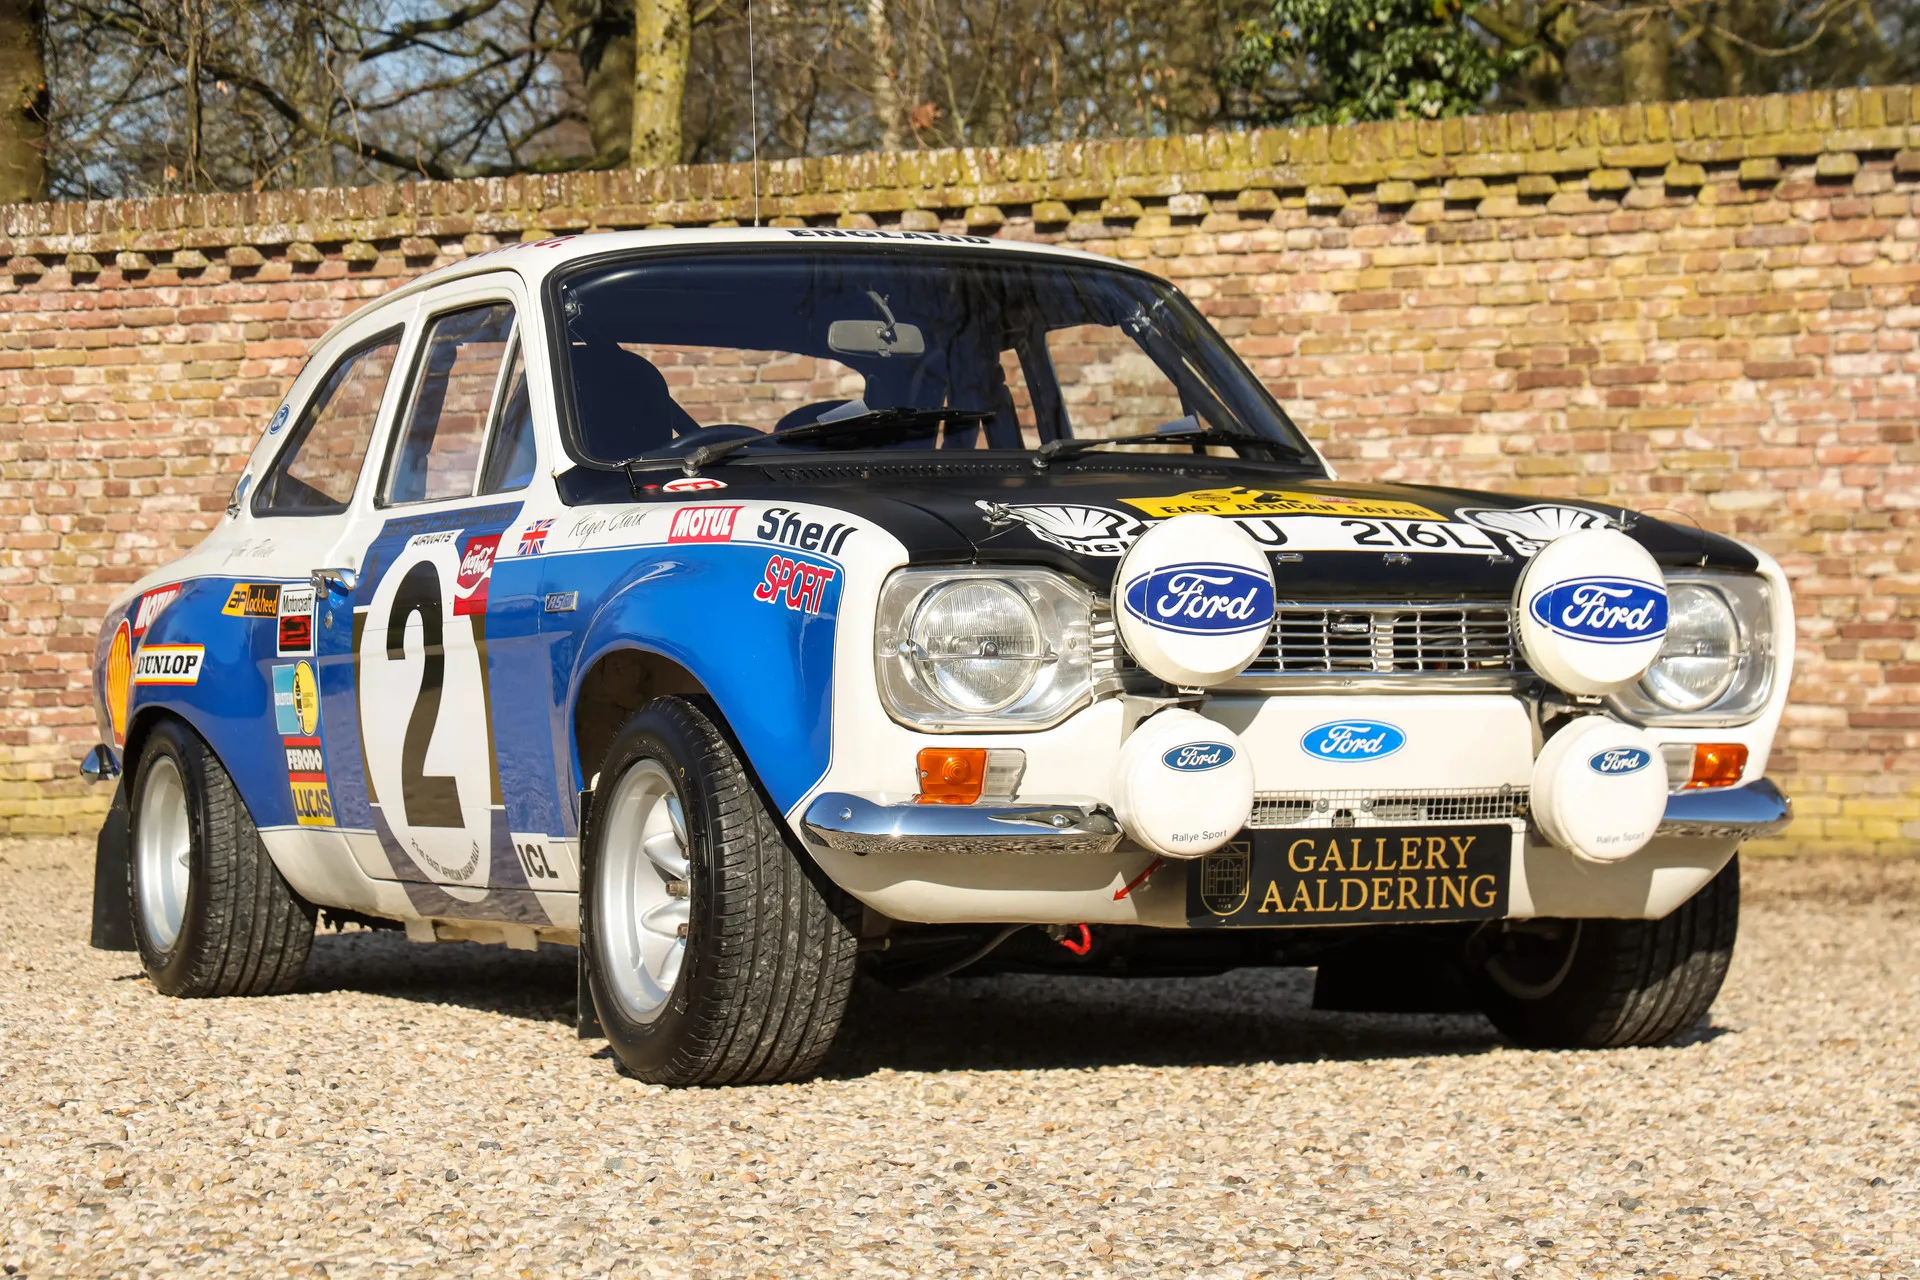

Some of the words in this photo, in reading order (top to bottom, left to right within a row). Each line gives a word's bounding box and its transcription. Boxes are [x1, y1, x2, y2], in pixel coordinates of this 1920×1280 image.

[786, 229, 991, 244] ENGLAND
[671, 507, 735, 538] MOTUL
[1160, 505, 1222, 514] EAST
[1236, 503, 1337, 512] AFRICAN
[1347, 506, 1431, 517] SAFARI
[412, 532, 455, 546] AIRWAYS
[757, 508, 858, 556] Shell
[1341, 520, 1495, 549] 216L
[755, 556, 836, 615] SPORT
[1157, 572, 1257, 620] Ford
[245, 588, 279, 615] Lockheed
[282, 594, 312, 613] Motorcraft
[1562, 584, 1655, 631] Ford
[137, 655, 198, 675] DUNLOP
[387, 560, 465, 829] 2
[1319, 725, 1386, 754] Ford
[286, 748, 323, 771] FERODO
[1177, 746, 1221, 767] Ford
[1600, 750, 1640, 772] Ford
[292, 788, 333, 818] LUCAS
[1172, 833, 1199, 843] Rallye
[1202, 830, 1227, 841] Sport
[1596, 835, 1620, 844] Rallye
[1623, 832, 1645, 842] Sport
[517, 844, 559, 880] ICL
[1287, 835, 1478, 873] GALLERY
[1257, 874, 1498, 914] AALDERING
